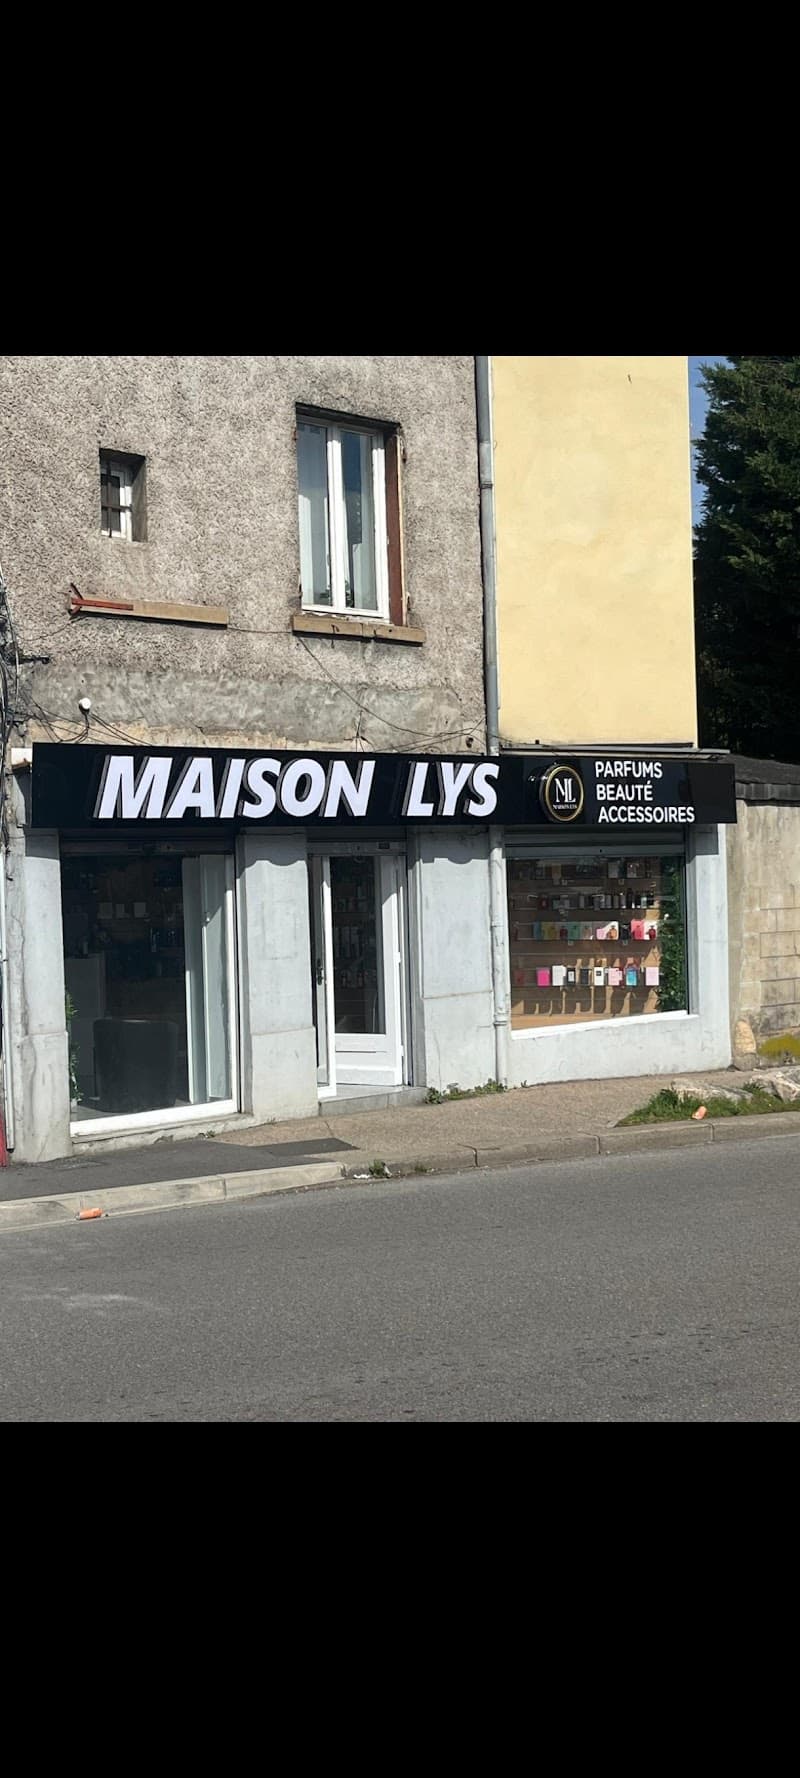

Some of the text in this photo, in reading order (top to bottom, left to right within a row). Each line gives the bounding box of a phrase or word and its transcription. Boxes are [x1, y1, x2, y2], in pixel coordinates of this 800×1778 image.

[595, 761, 662, 778] PARFUMS
[95, 755, 499, 819] MAISON LYS
[596, 781, 653, 801] BEAUTÉ
[598, 806, 695, 823] ACCESSOIRES
